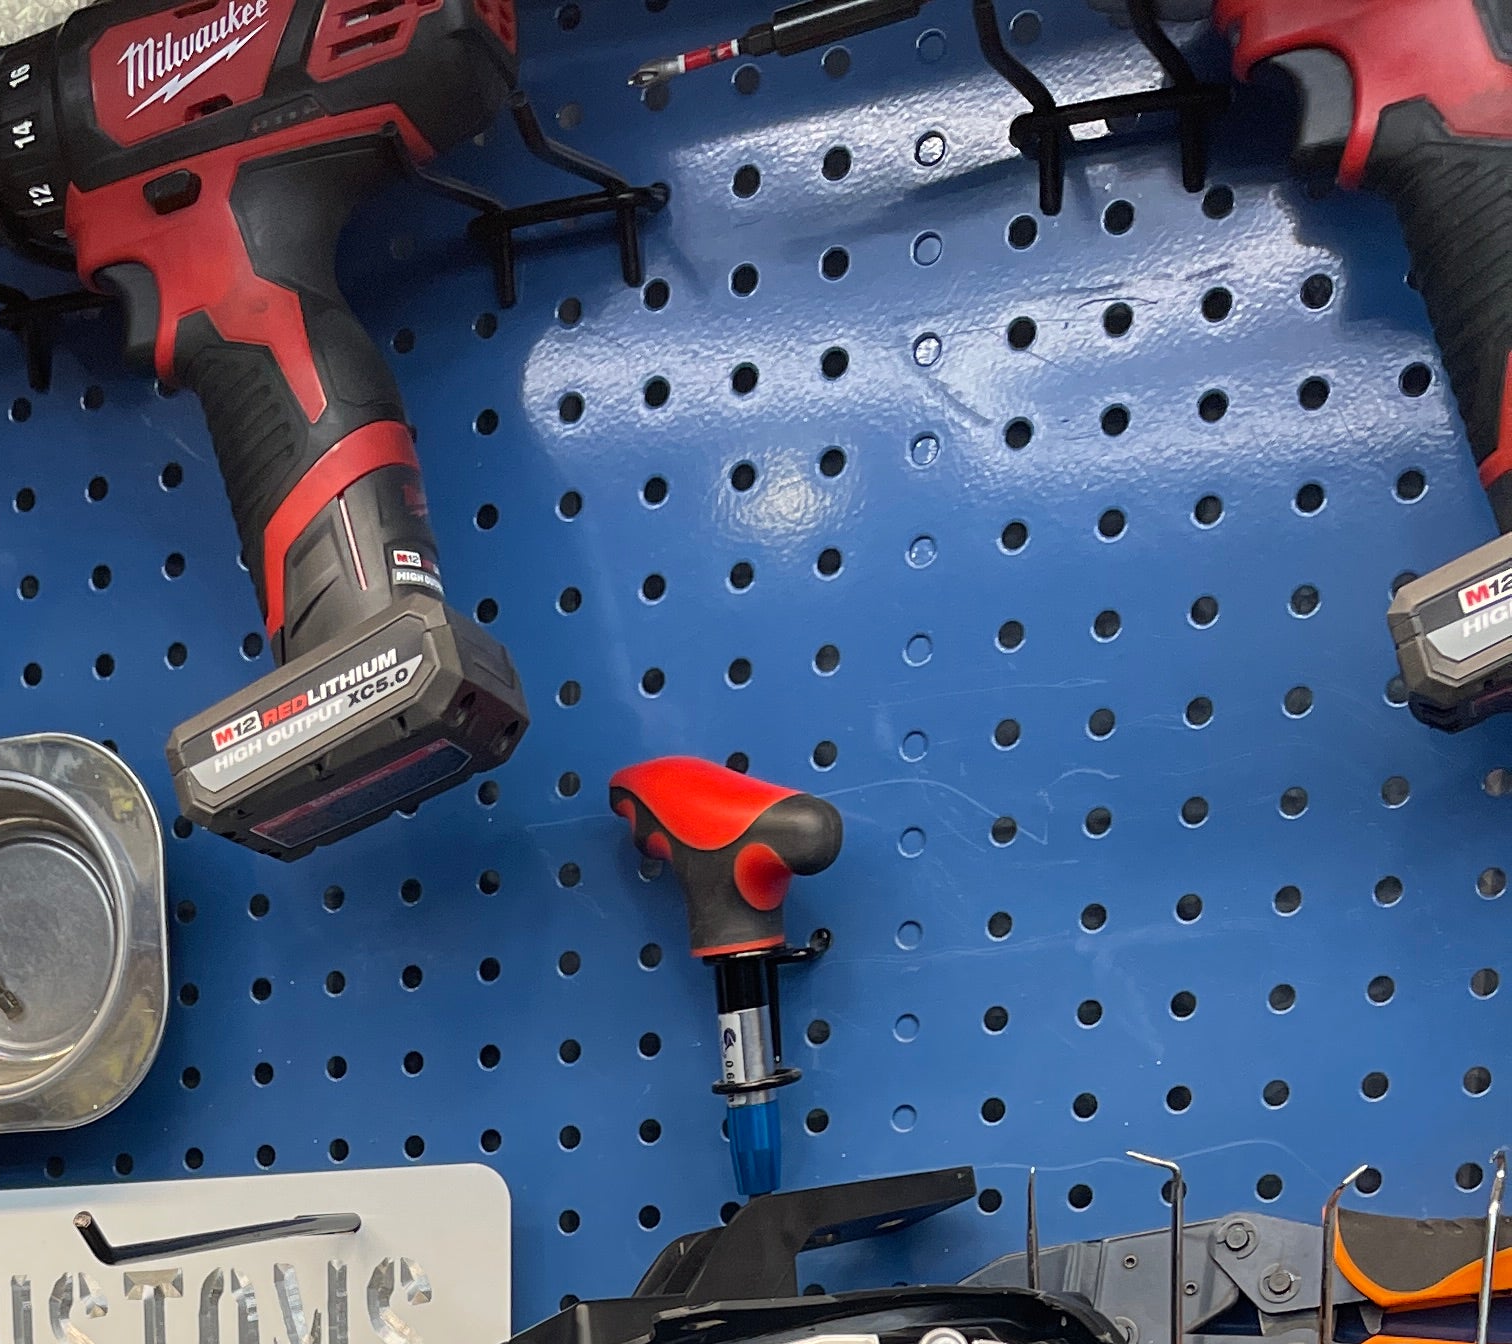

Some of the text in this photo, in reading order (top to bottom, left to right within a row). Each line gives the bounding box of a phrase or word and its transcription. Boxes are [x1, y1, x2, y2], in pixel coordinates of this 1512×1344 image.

[117, 0, 269, 98] Milwaukee
[9, 63, 31, 88] 16
[12, 120, 35, 149] 14
[28, 183, 54, 206] 12
[1463, 603, 1512, 637] HIG
[215, 648, 397, 746] M12 REDLITHIUM
[214, 667, 408, 773] HIGH OUTPUT XC5.0
